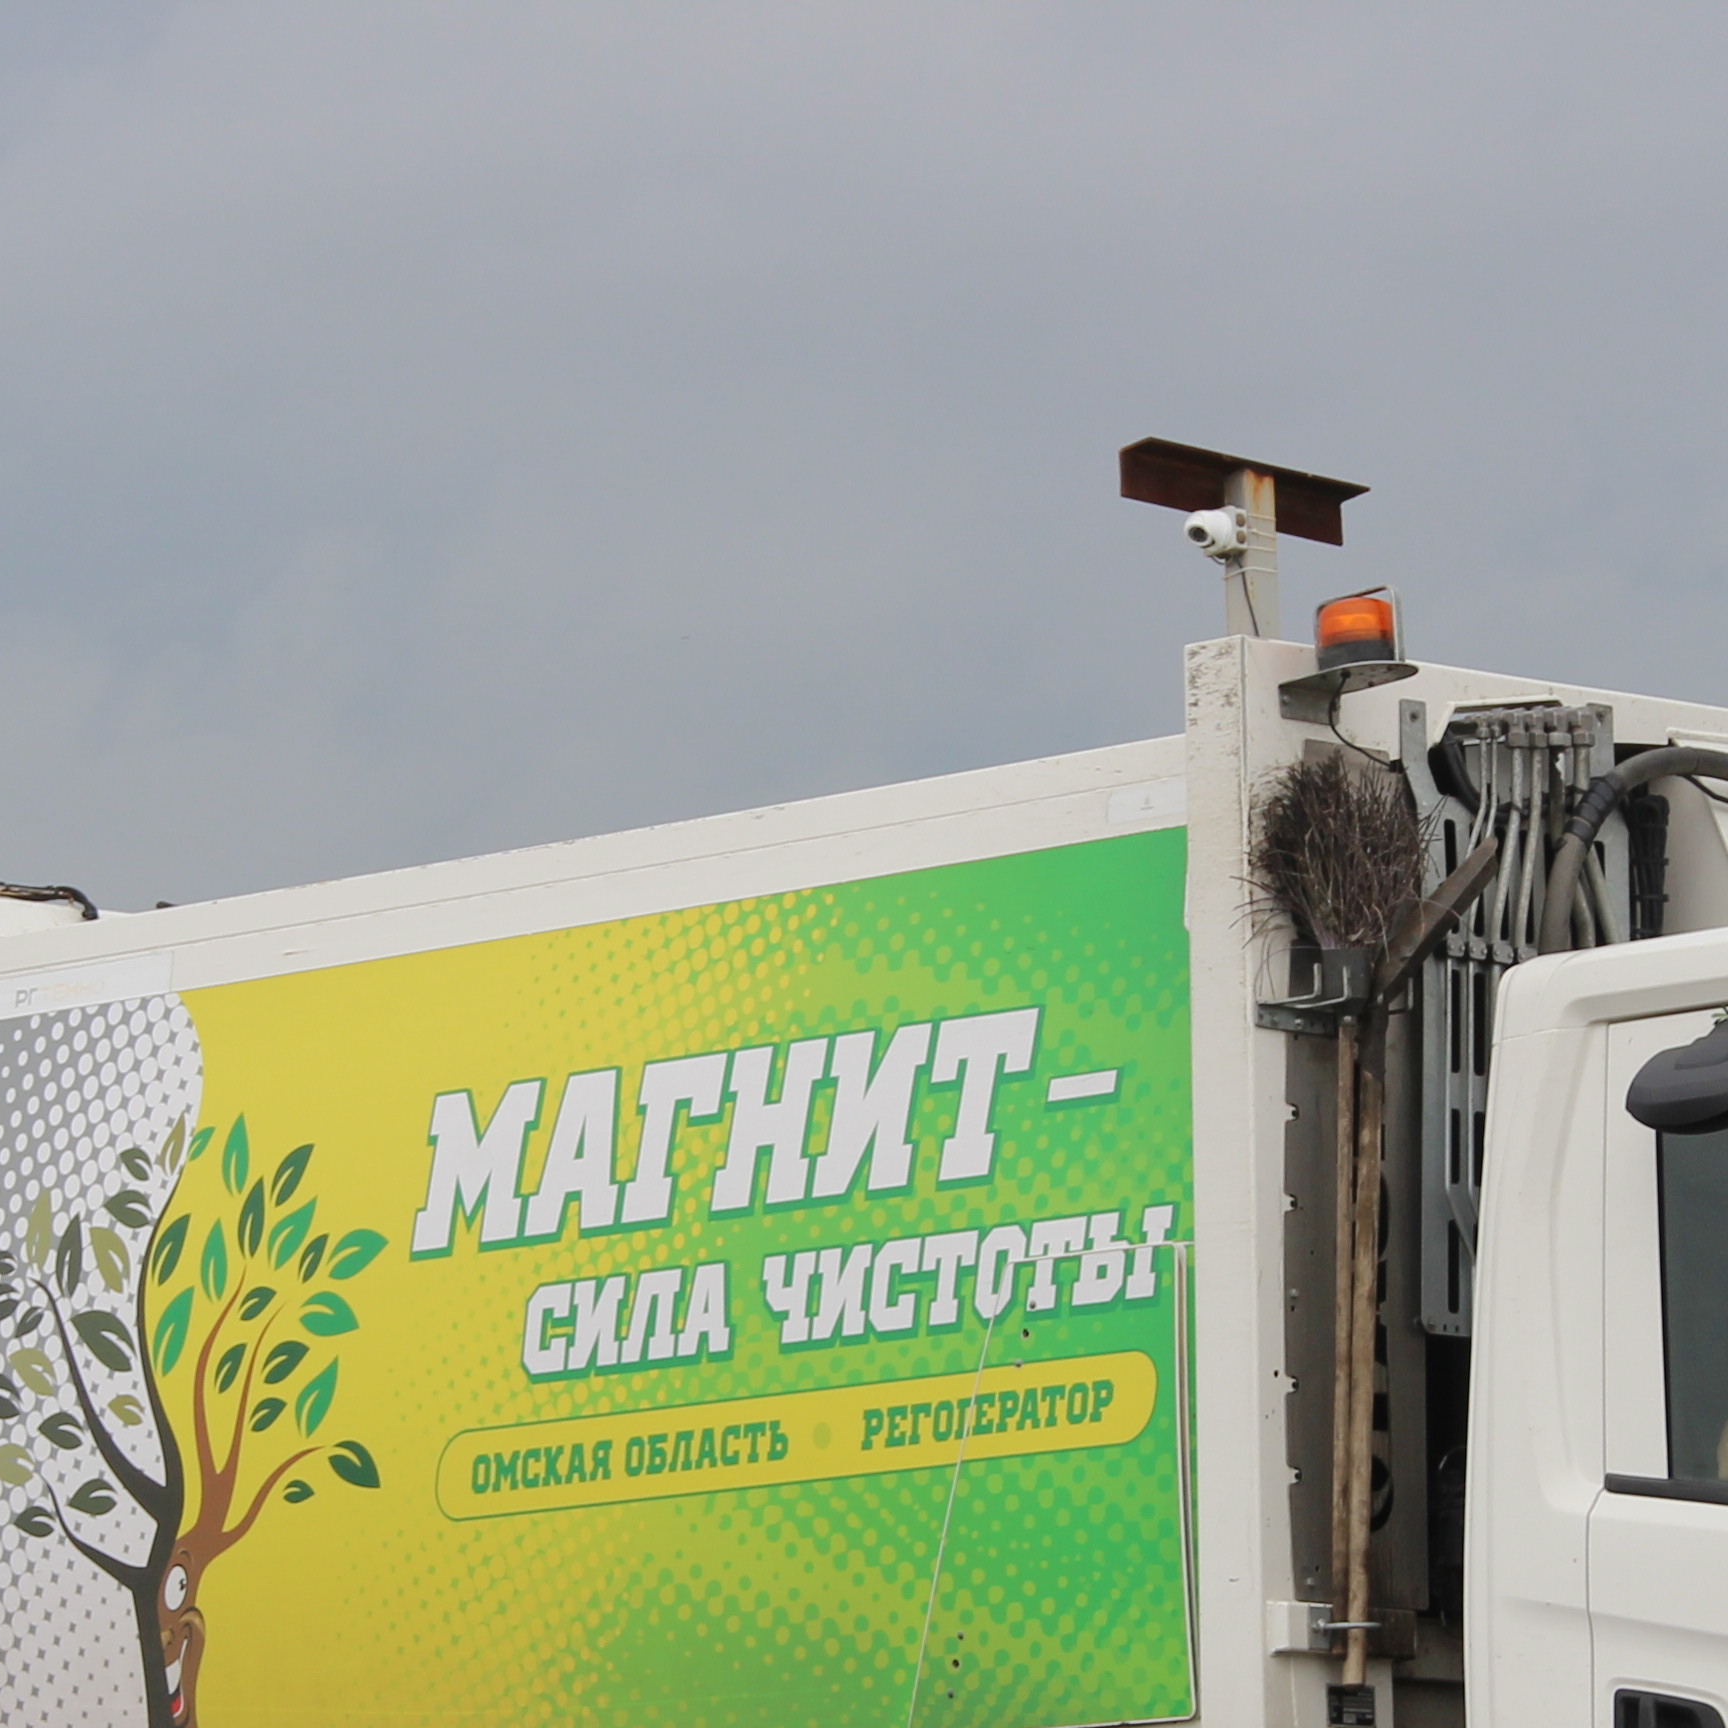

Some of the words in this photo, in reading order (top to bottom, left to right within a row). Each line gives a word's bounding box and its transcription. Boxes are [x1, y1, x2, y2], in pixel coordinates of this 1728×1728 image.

[410, 1007, 1041, 1257] МАГНИТ
[521, 1262, 731, 1377] СИЛА
[762, 1203, 1174, 1346] ЧИСТОТЫ
[471, 1439, 613, 1494] ОМСКАЯ
[624, 1419, 789, 1478] ОБЛАСТЬ
